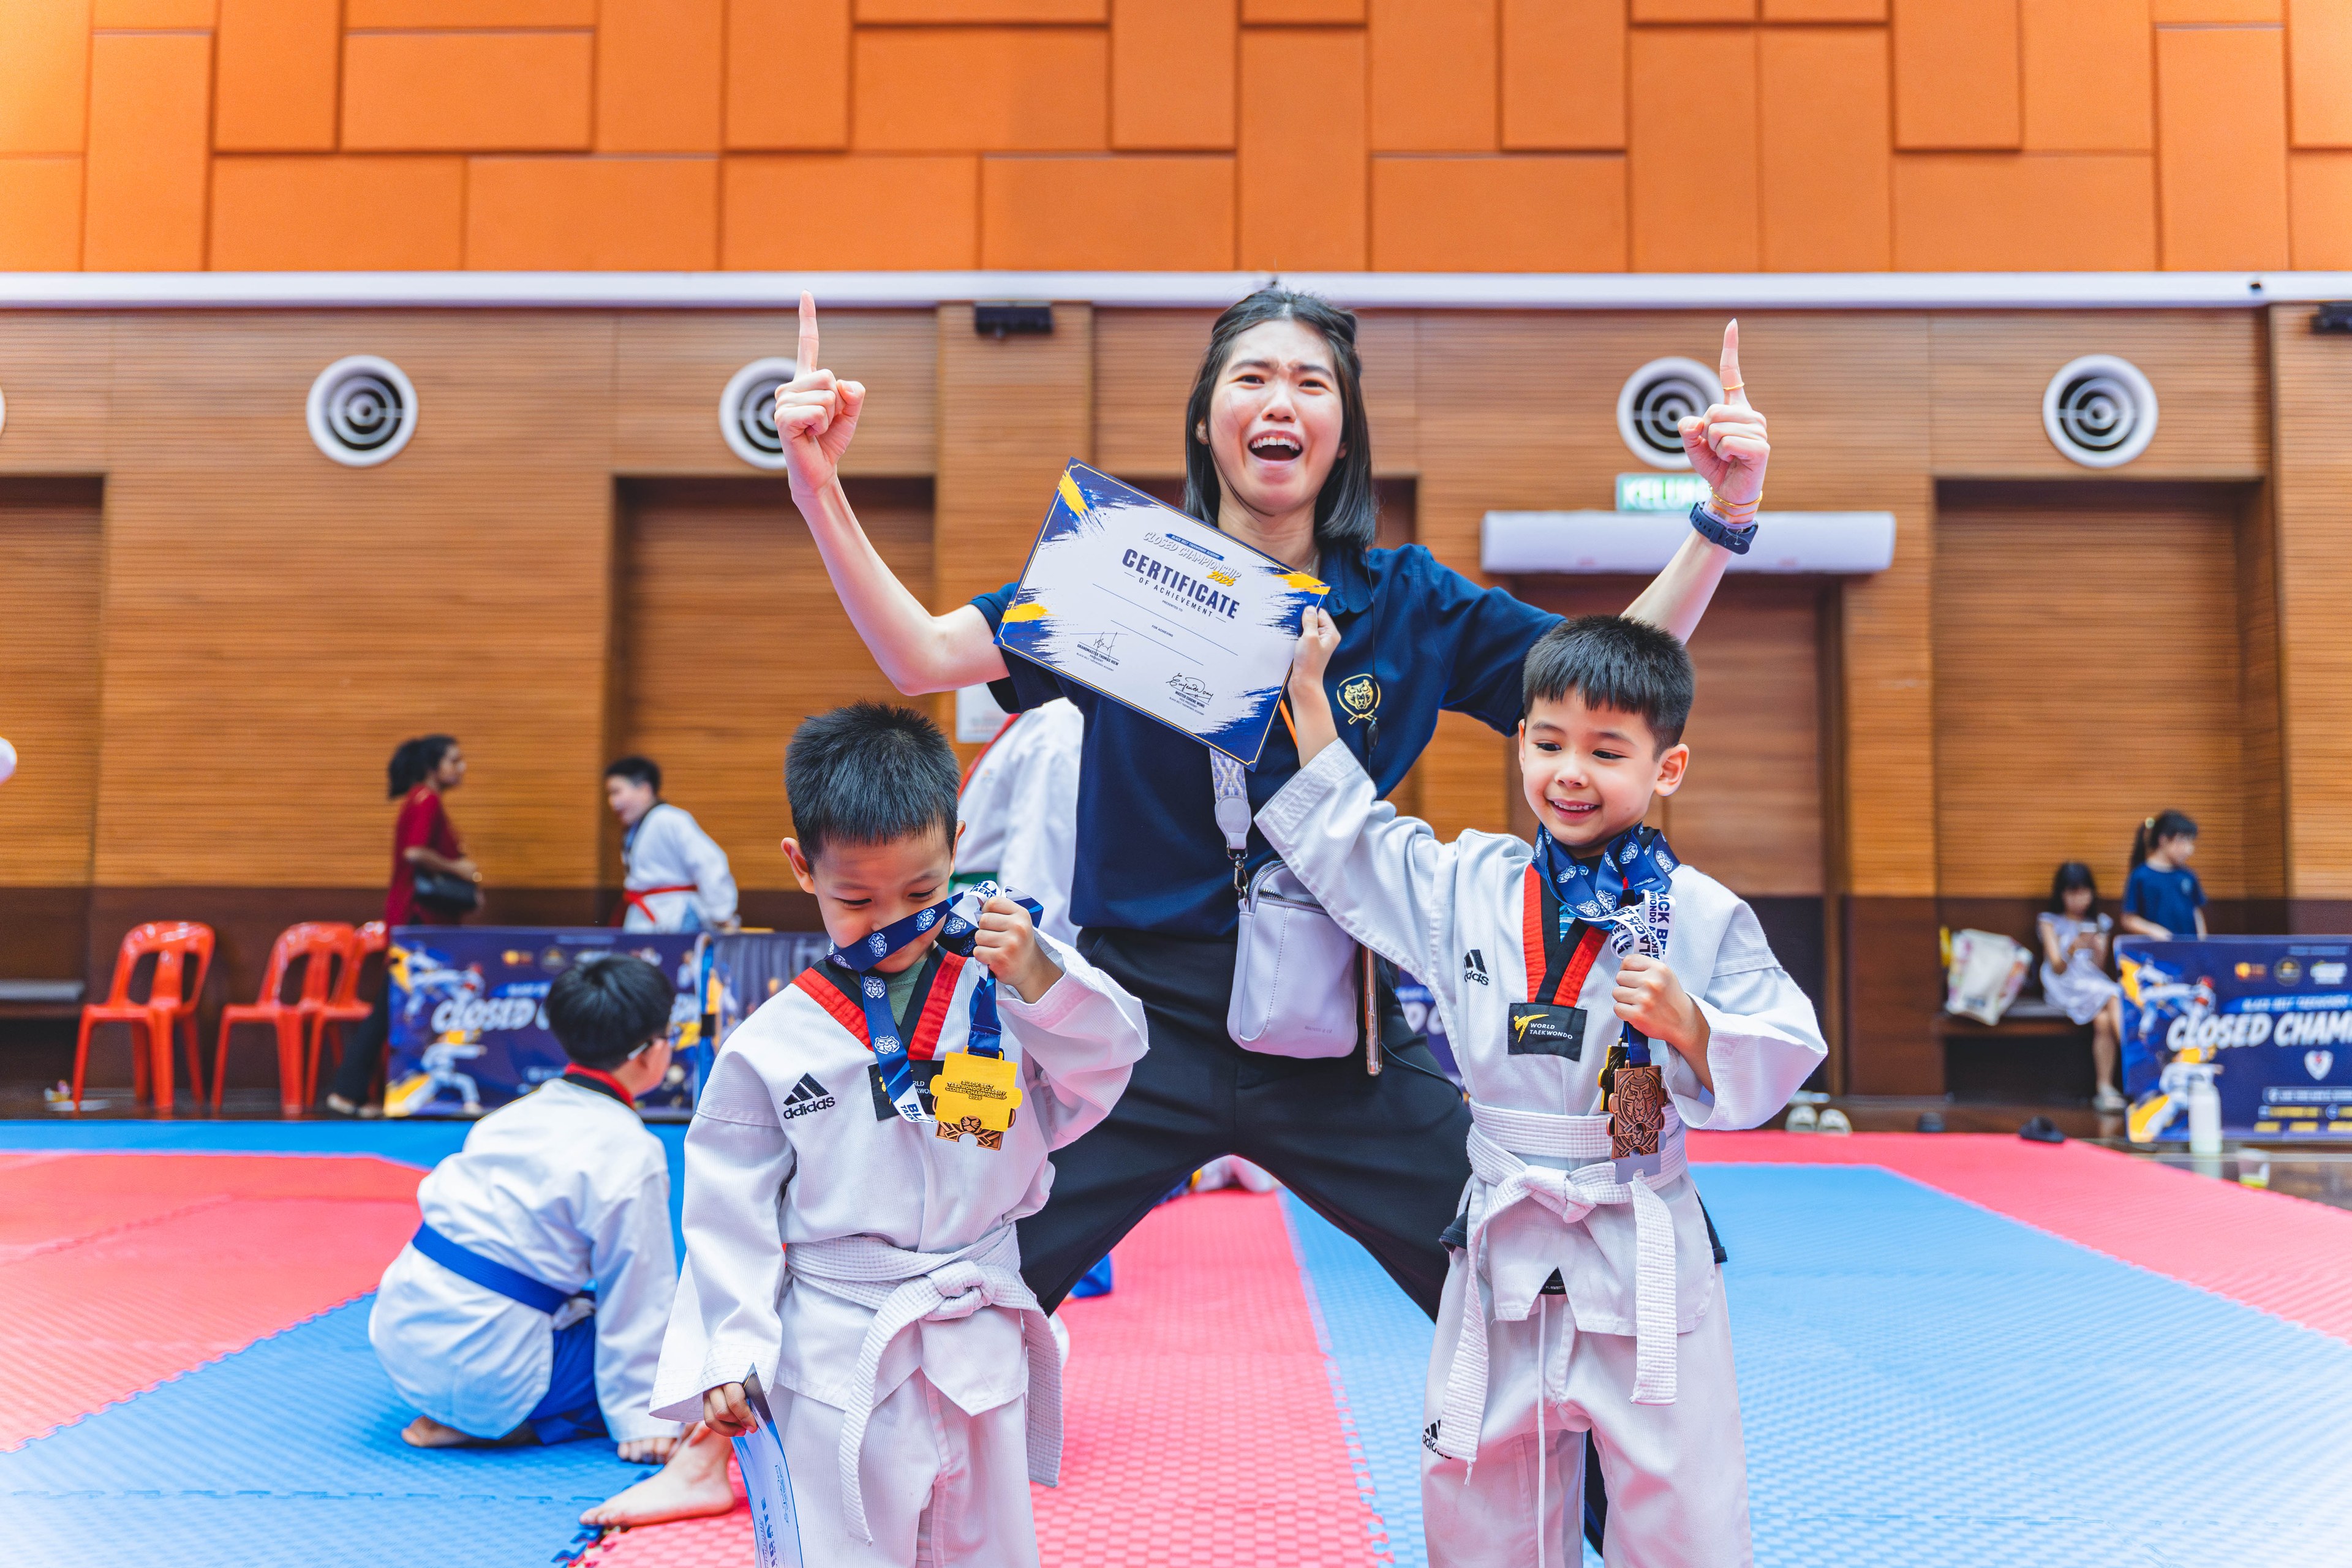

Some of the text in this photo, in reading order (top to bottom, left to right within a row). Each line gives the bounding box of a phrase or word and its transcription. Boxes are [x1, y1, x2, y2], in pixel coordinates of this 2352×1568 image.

[1142, 532, 1242, 579] CLOSED CHAMPIONSHIP
[1122, 549, 1240, 619] CERTIFICATE
[1206, 570, 1236, 587] 2026
[1139, 577, 1213, 617] OF ACHIEVEMENT
[1162, 600, 1179, 611] PRESENTED
[1158, 627, 1174, 638] ACHIEVING
[1077, 644, 1099, 657] GRANDMASTER
[1099, 654, 1111, 662] THOMAS
[1175, 690, 1186, 699] MASTER
[1529, 1030, 1573, 1039] TAEKWONDO
[2166, 1010, 2352, 1051] CLOSED CHAM
[947, 1082, 980, 1091] TAEKWONDO
[967, 1090, 1007, 1100] CHAMPIONSHIP
[783, 1096, 835, 1119] adidas
